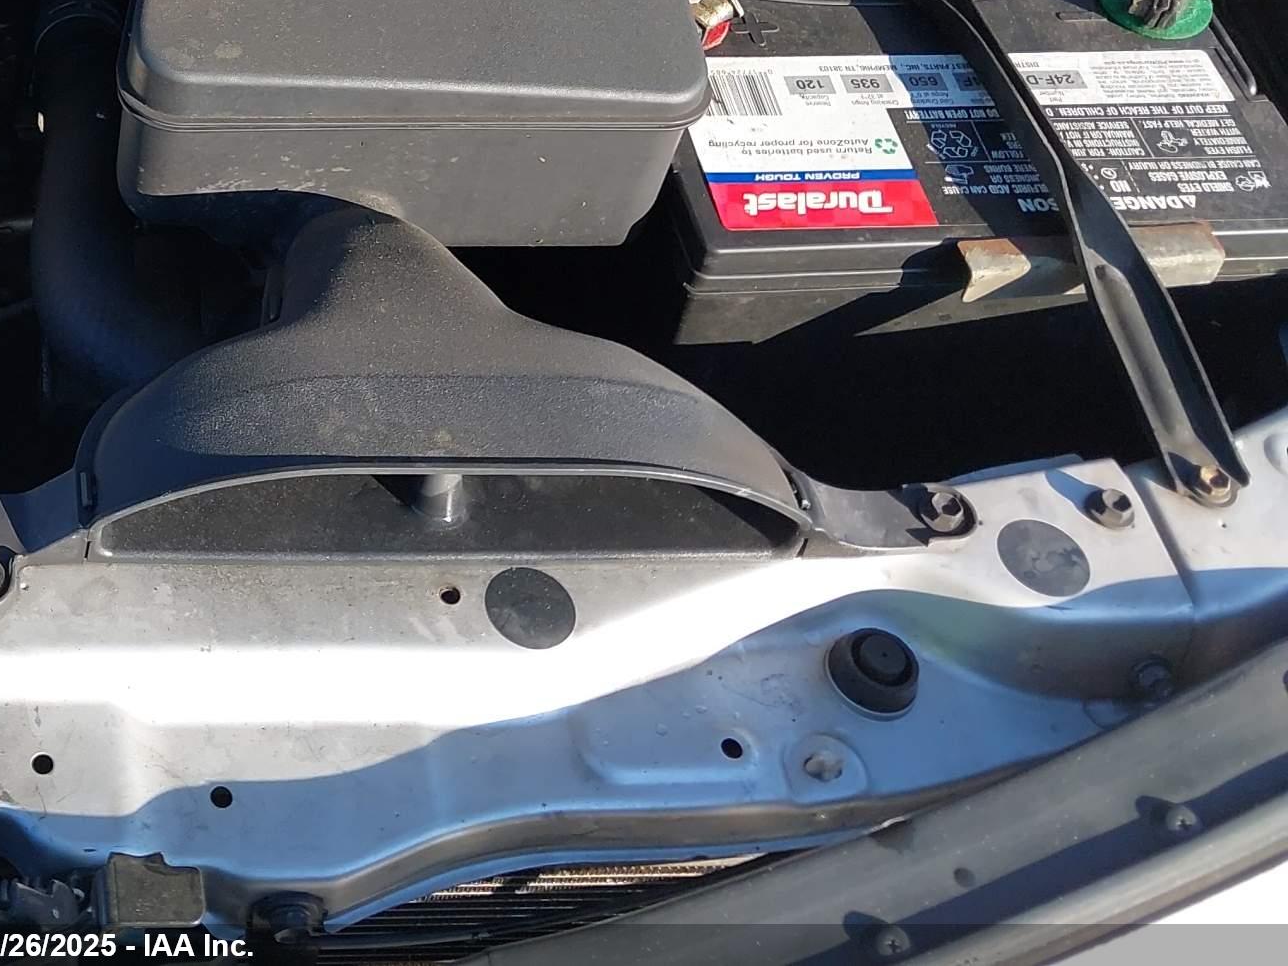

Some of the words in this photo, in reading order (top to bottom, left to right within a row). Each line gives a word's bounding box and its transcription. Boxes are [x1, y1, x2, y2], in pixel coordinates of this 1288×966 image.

[850, 79, 879, 88] 935
[909, 76, 938, 86] 650
[1025, 74, 1074, 85] 24F-D
[796, 80, 824, 89] 120
[1107, 107, 1118, 116] OF
[1119, 106, 1150, 116] REACH
[1151, 106, 1170, 114] THE
[1170, 106, 1183, 114] OF
[1184, 105, 1204, 114] OUT
[1205, 104, 1228, 113] KEEP
[943, 110, 967, 118] OPEN
[1053, 121, 1095, 129] ASSISTANC
[1163, 120, 1184, 128] HELP
[709, 140, 756, 148] recycling
[759, 139, 795, 147] proper
[816, 139, 869, 147] AutoZone
[1216, 160, 1243, 168] CAUSE
[754, 173, 800, 181] TOUGH
[804, 172, 860, 180] PROVEN
[1148, 172, 1179, 181] GASES
[942, 186, 970, 195] CAUSE
[970, 185, 987, 194] CAN
[988, 185, 1009, 194] ACID
[1012, 184, 1048, 193] ULFURIC
[1177, 183, 1202, 192] EYES
[743, 190, 893, 216] Duralast
[1108, 195, 1181, 210] DANGE
